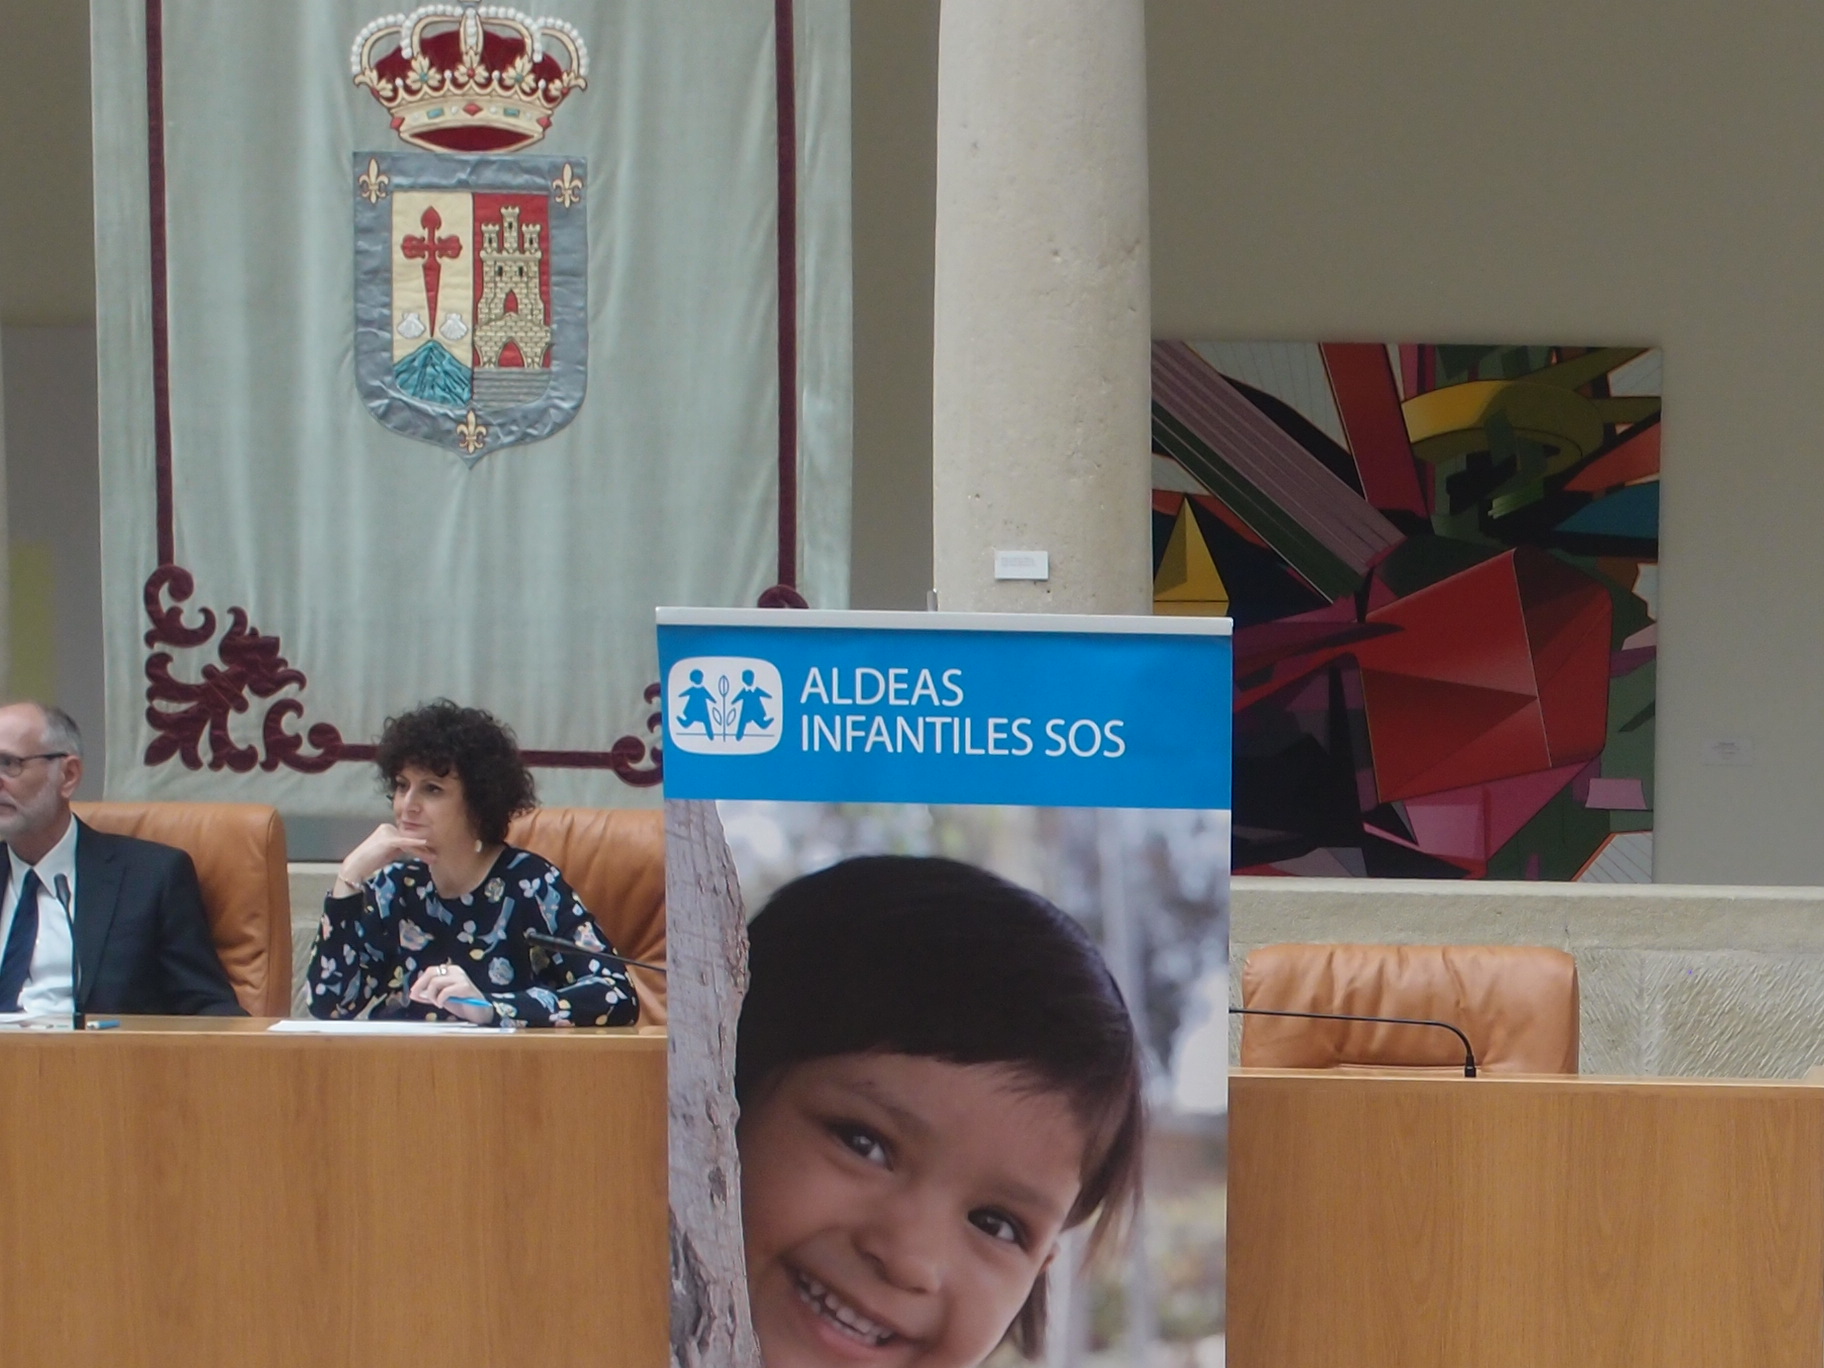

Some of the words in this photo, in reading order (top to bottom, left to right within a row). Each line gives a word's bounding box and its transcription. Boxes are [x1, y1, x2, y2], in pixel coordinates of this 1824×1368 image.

[800, 666, 964, 707] ALDEAS
[801, 715, 1033, 757] INFANTILES
[1044, 719, 1127, 758] SOS
